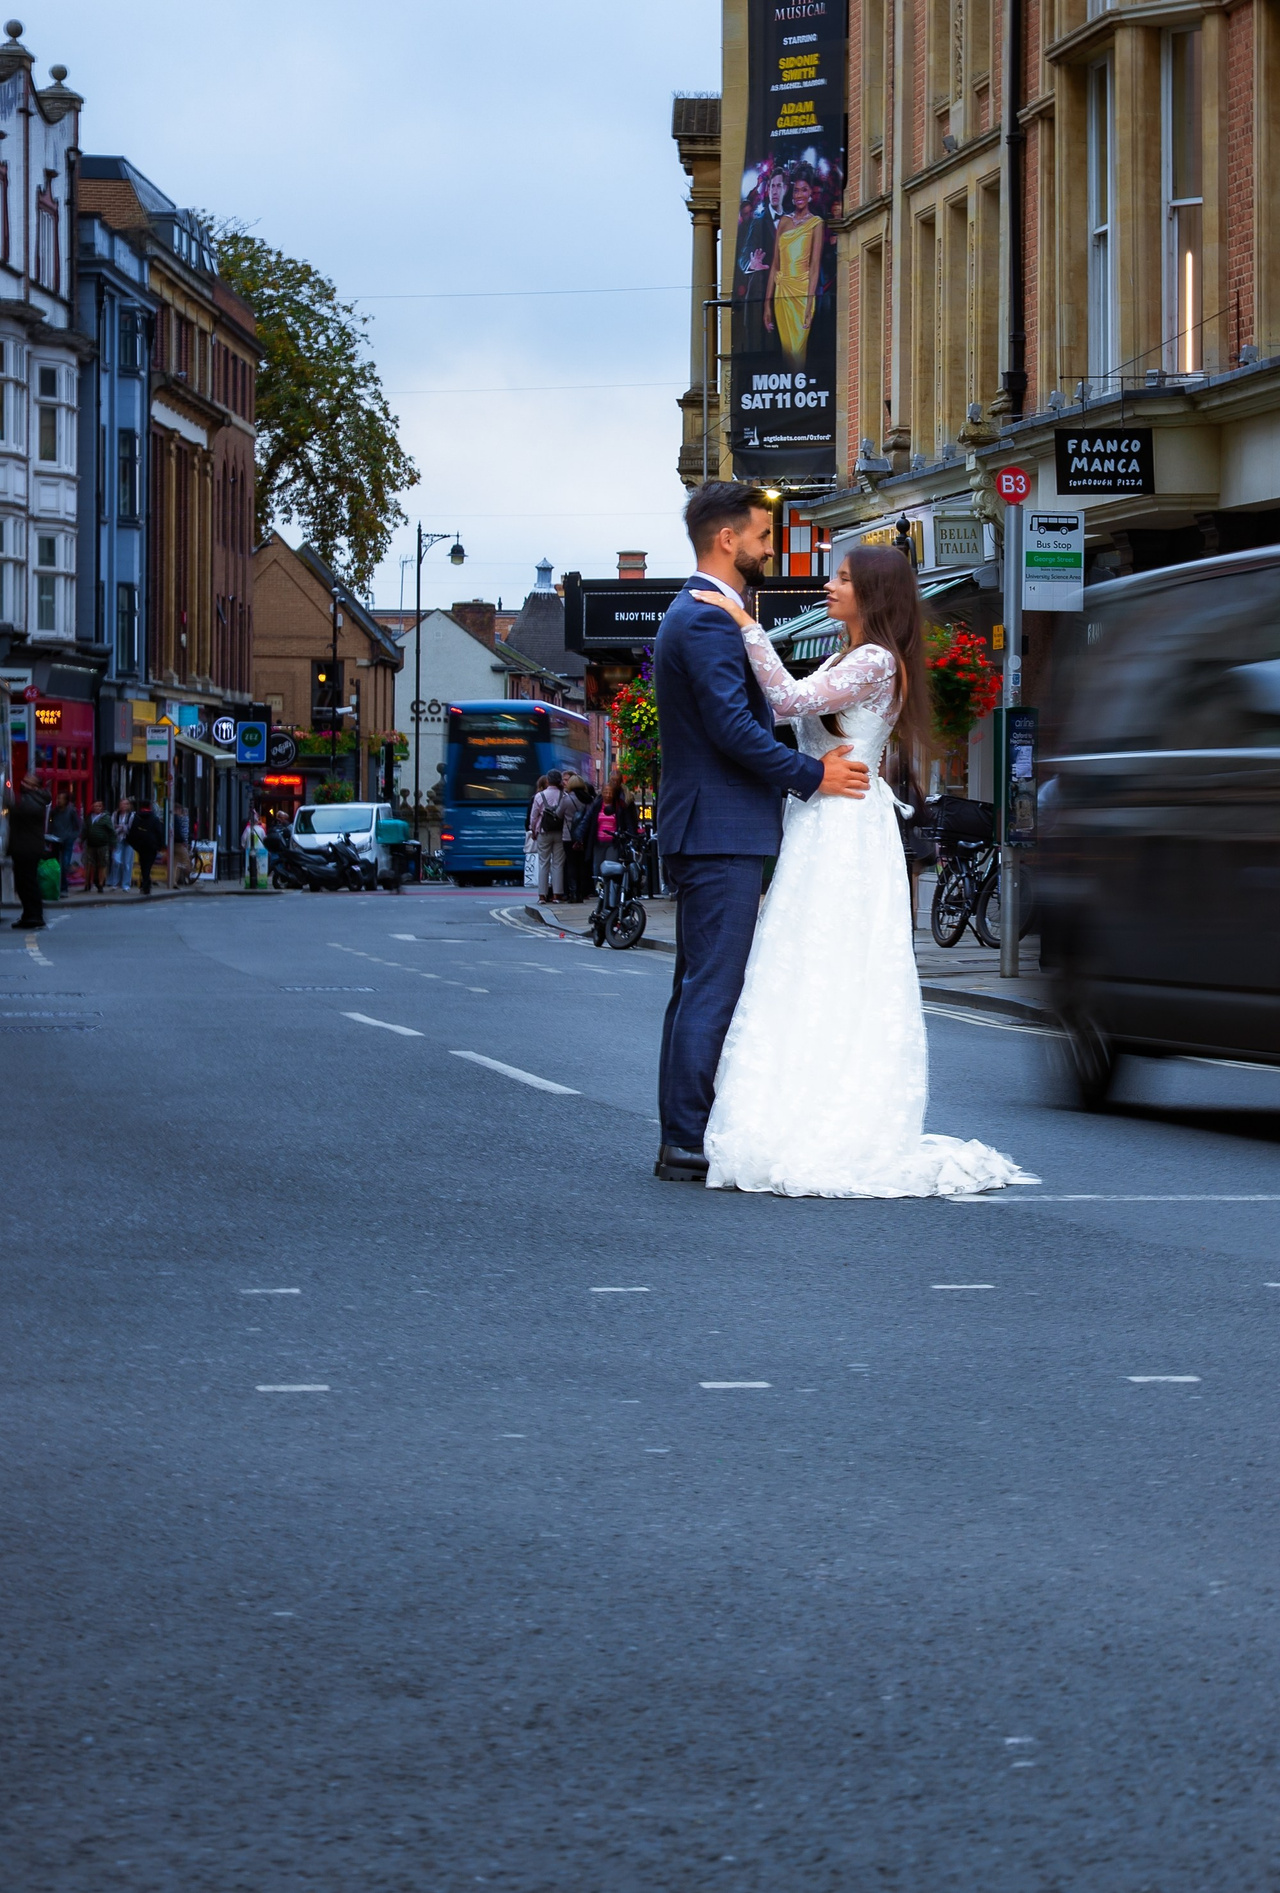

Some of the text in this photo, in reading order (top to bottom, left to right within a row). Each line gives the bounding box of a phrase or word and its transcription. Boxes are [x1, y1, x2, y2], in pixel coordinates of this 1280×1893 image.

[774, 2, 827, 21] MUSICAL
[783, 33, 818, 46] STARRING
[779, 53, 820, 70] SIDONIE
[782, 67, 816, 82] SMITH
[781, 101, 815, 115] ADAM
[776, 114, 817, 128] GARCIA
[752, 373, 792, 391] MON
[794, 372, 807, 389] 6
[741, 391, 830, 410] SAT 11 OCT
[1067, 439, 1141, 454] FRANCO
[1070, 457, 1141, 473] MANCA
[1002, 475, 1026, 493] B3
[1069, 479, 1112, 487] SOURDOUGH
[940, 528, 977, 540] BELLA
[940, 542, 979, 554] ITALIA
[1036, 540, 1072, 550] Bus Stop
[1033, 555, 1075, 564] George Street
[1025, 573, 1050, 581] University
[614, 611, 639, 621] ENJOY
[640, 611, 657, 621] THE
[26, 687, 37, 698] A2
[244, 733, 258, 741] ZEZ
[525, 853, 536, 885] M&S
